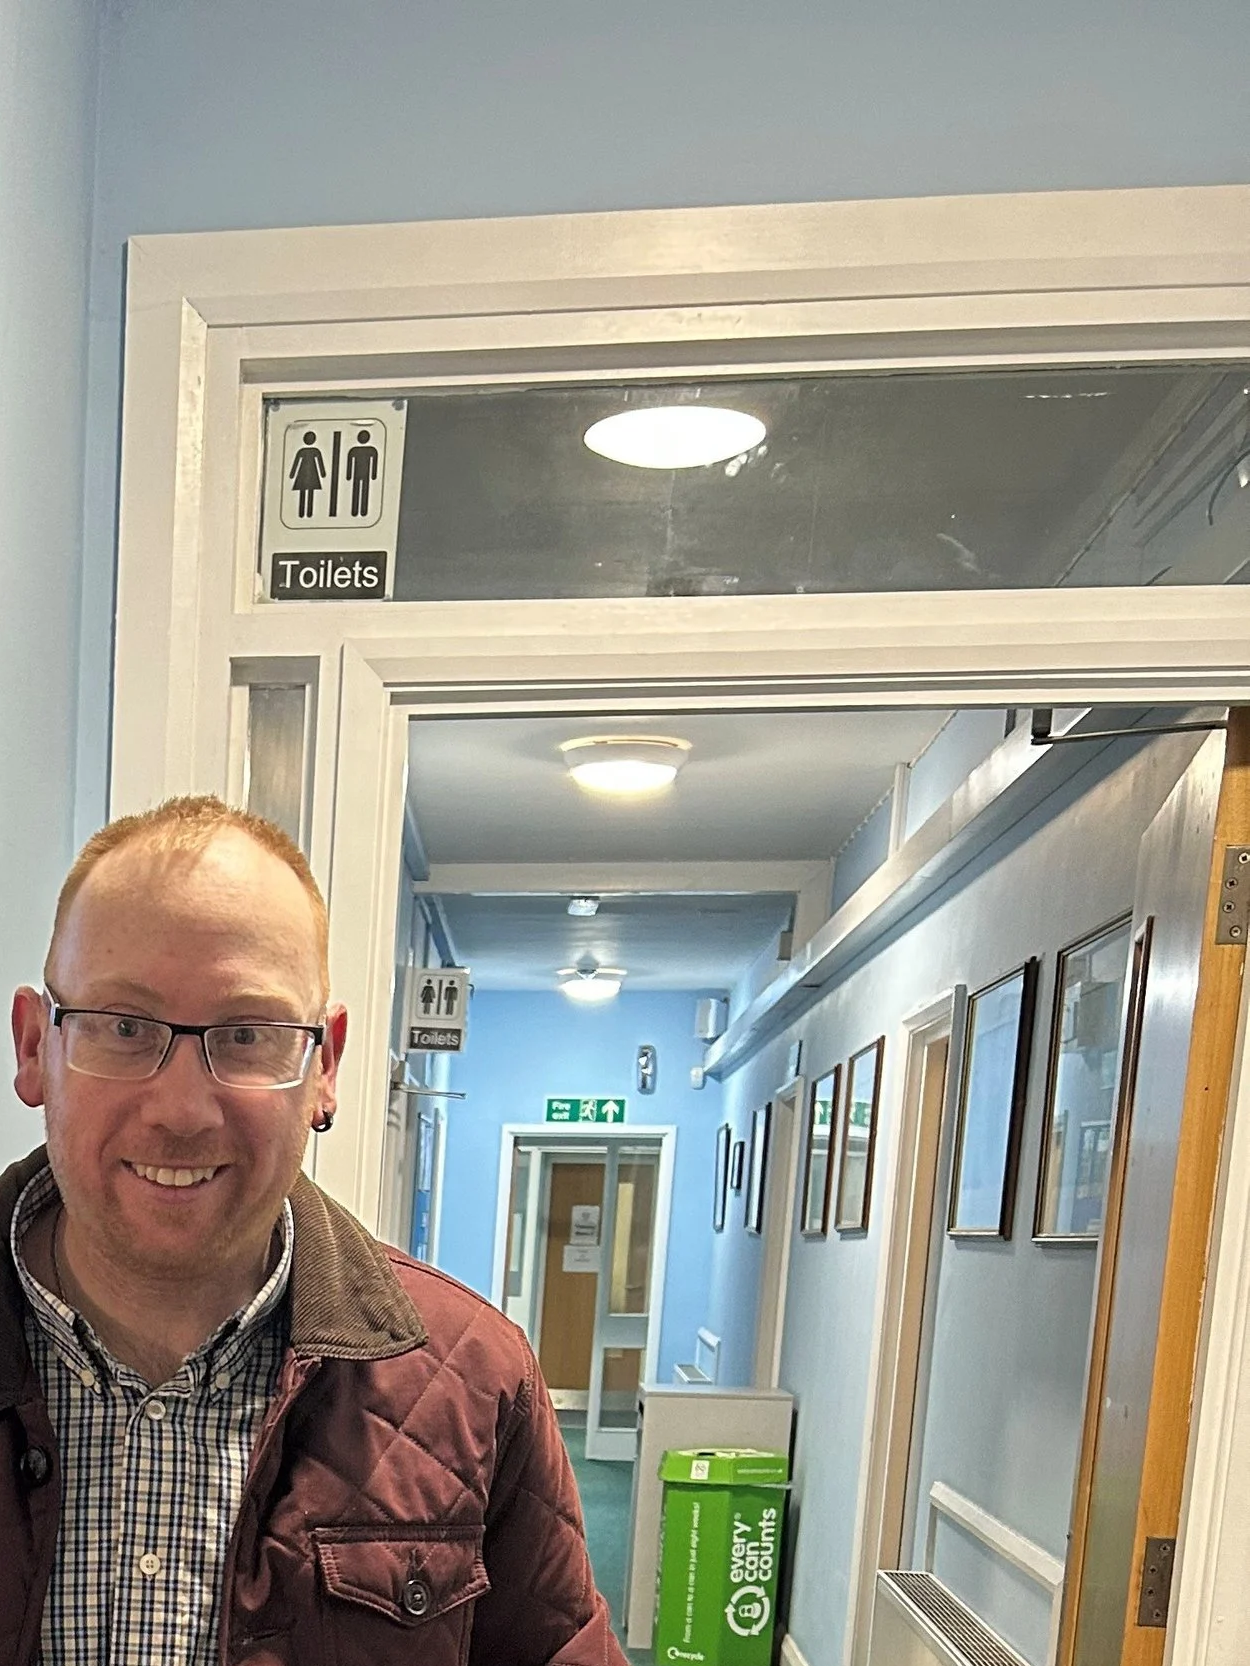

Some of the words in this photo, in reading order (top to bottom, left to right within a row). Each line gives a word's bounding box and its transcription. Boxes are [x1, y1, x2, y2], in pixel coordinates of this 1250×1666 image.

[279, 560, 379, 588] Toilets
[412, 1031, 459, 1046] Toilets
[730, 1518, 752, 1583] every
[744, 1541, 760, 1582] can
[758, 1507, 777, 1582] counts
